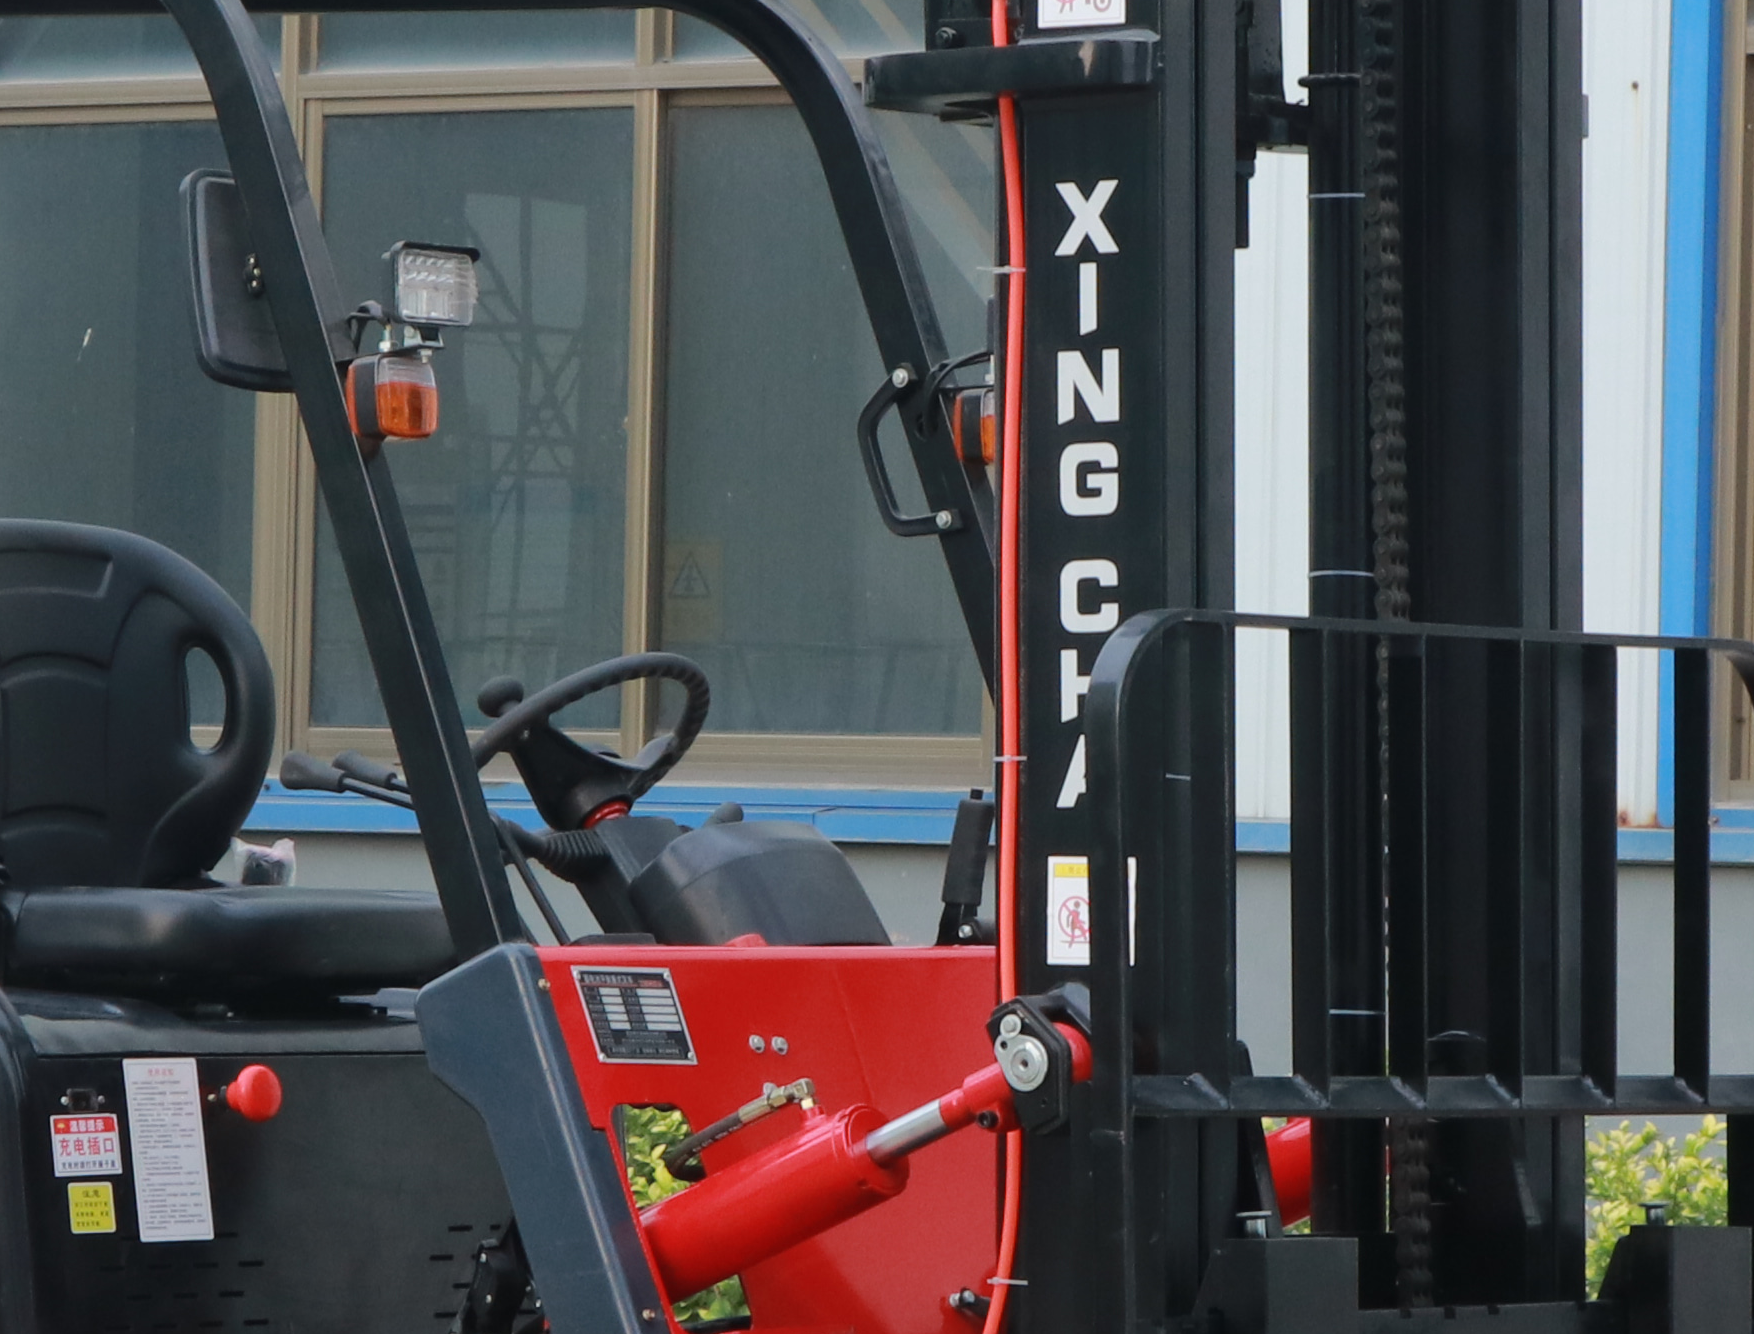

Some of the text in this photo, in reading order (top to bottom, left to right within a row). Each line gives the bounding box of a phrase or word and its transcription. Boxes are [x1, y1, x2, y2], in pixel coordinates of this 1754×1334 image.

[69, 1119, 105, 1132] 温馨提示
[58, 1136, 115, 1157] 充电插口
